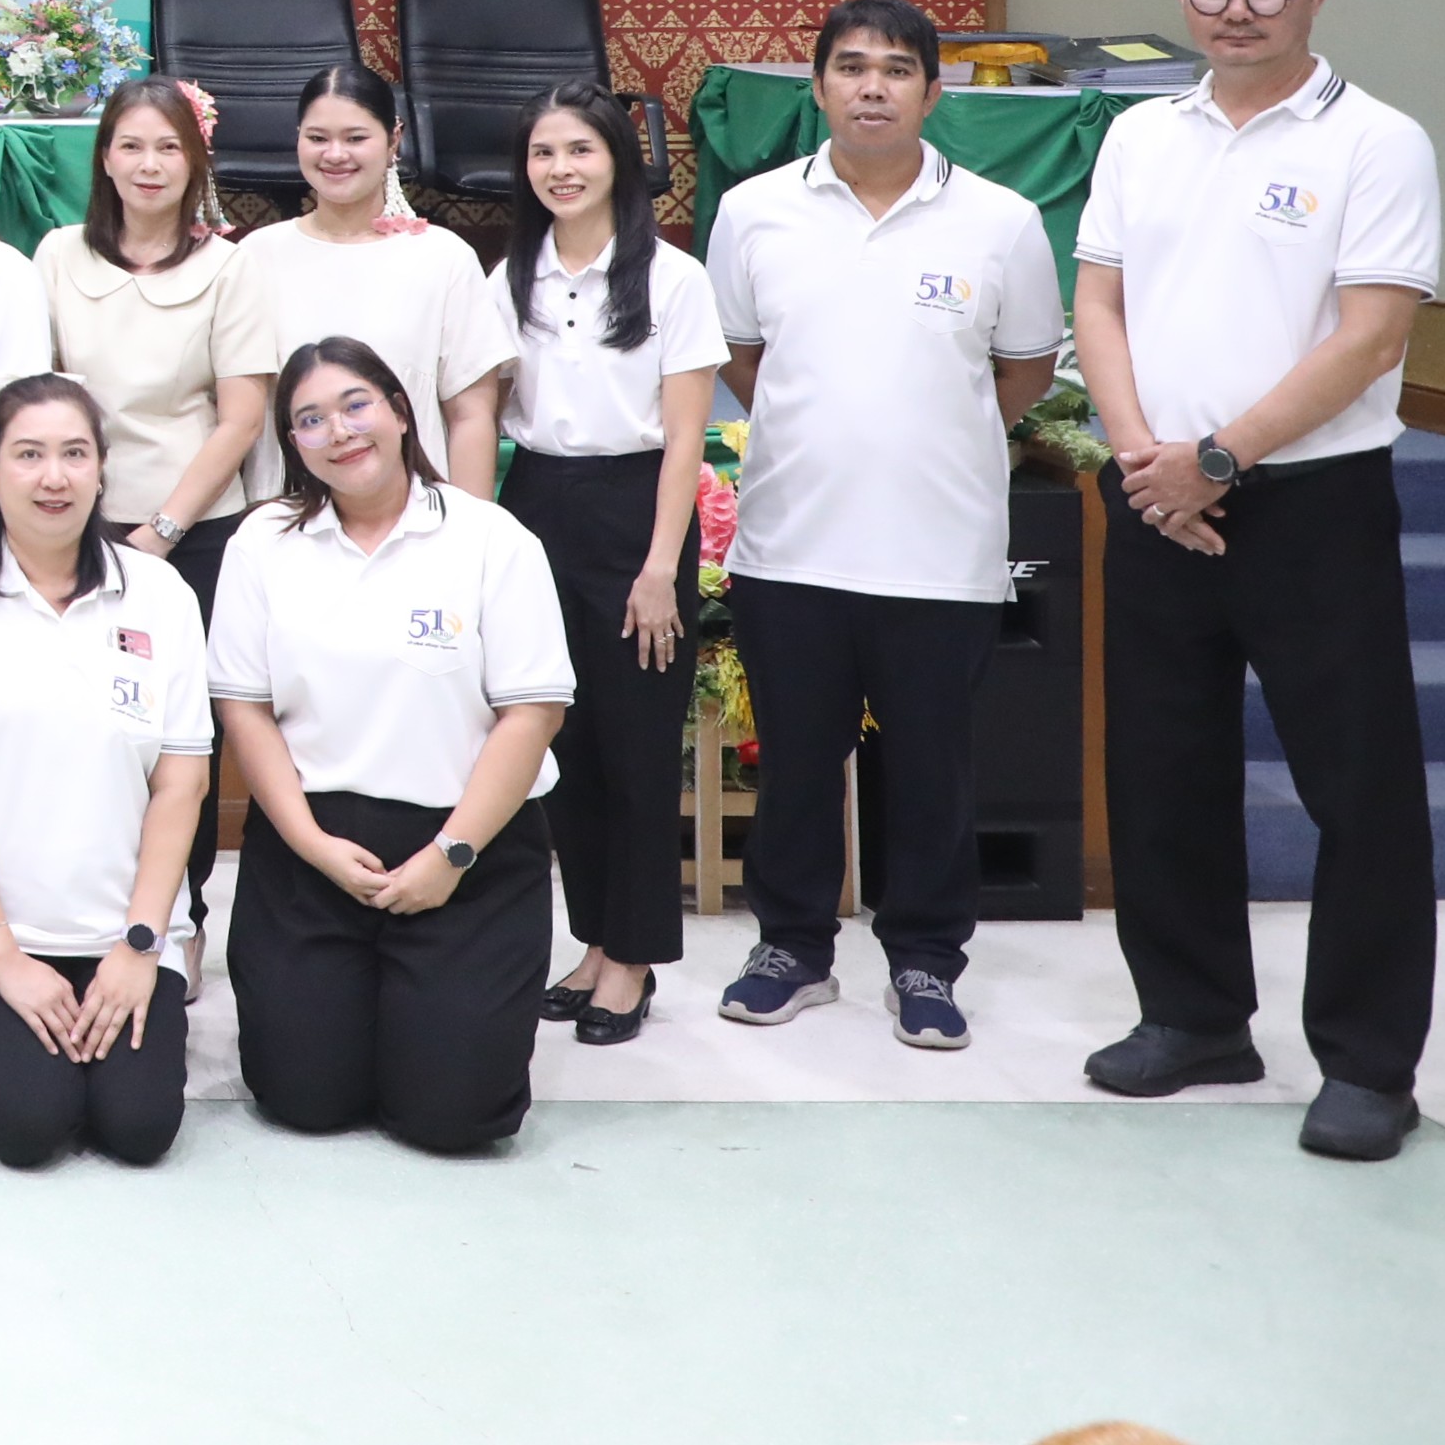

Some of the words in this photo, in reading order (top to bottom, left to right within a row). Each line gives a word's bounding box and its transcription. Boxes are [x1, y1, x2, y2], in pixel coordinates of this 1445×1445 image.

[1258, 182, 1298, 212] 51
[915, 272, 954, 301] 51
[606, 315, 659, 337] MC
[407, 609, 445, 639] 51
[110, 675, 141, 707] 51
